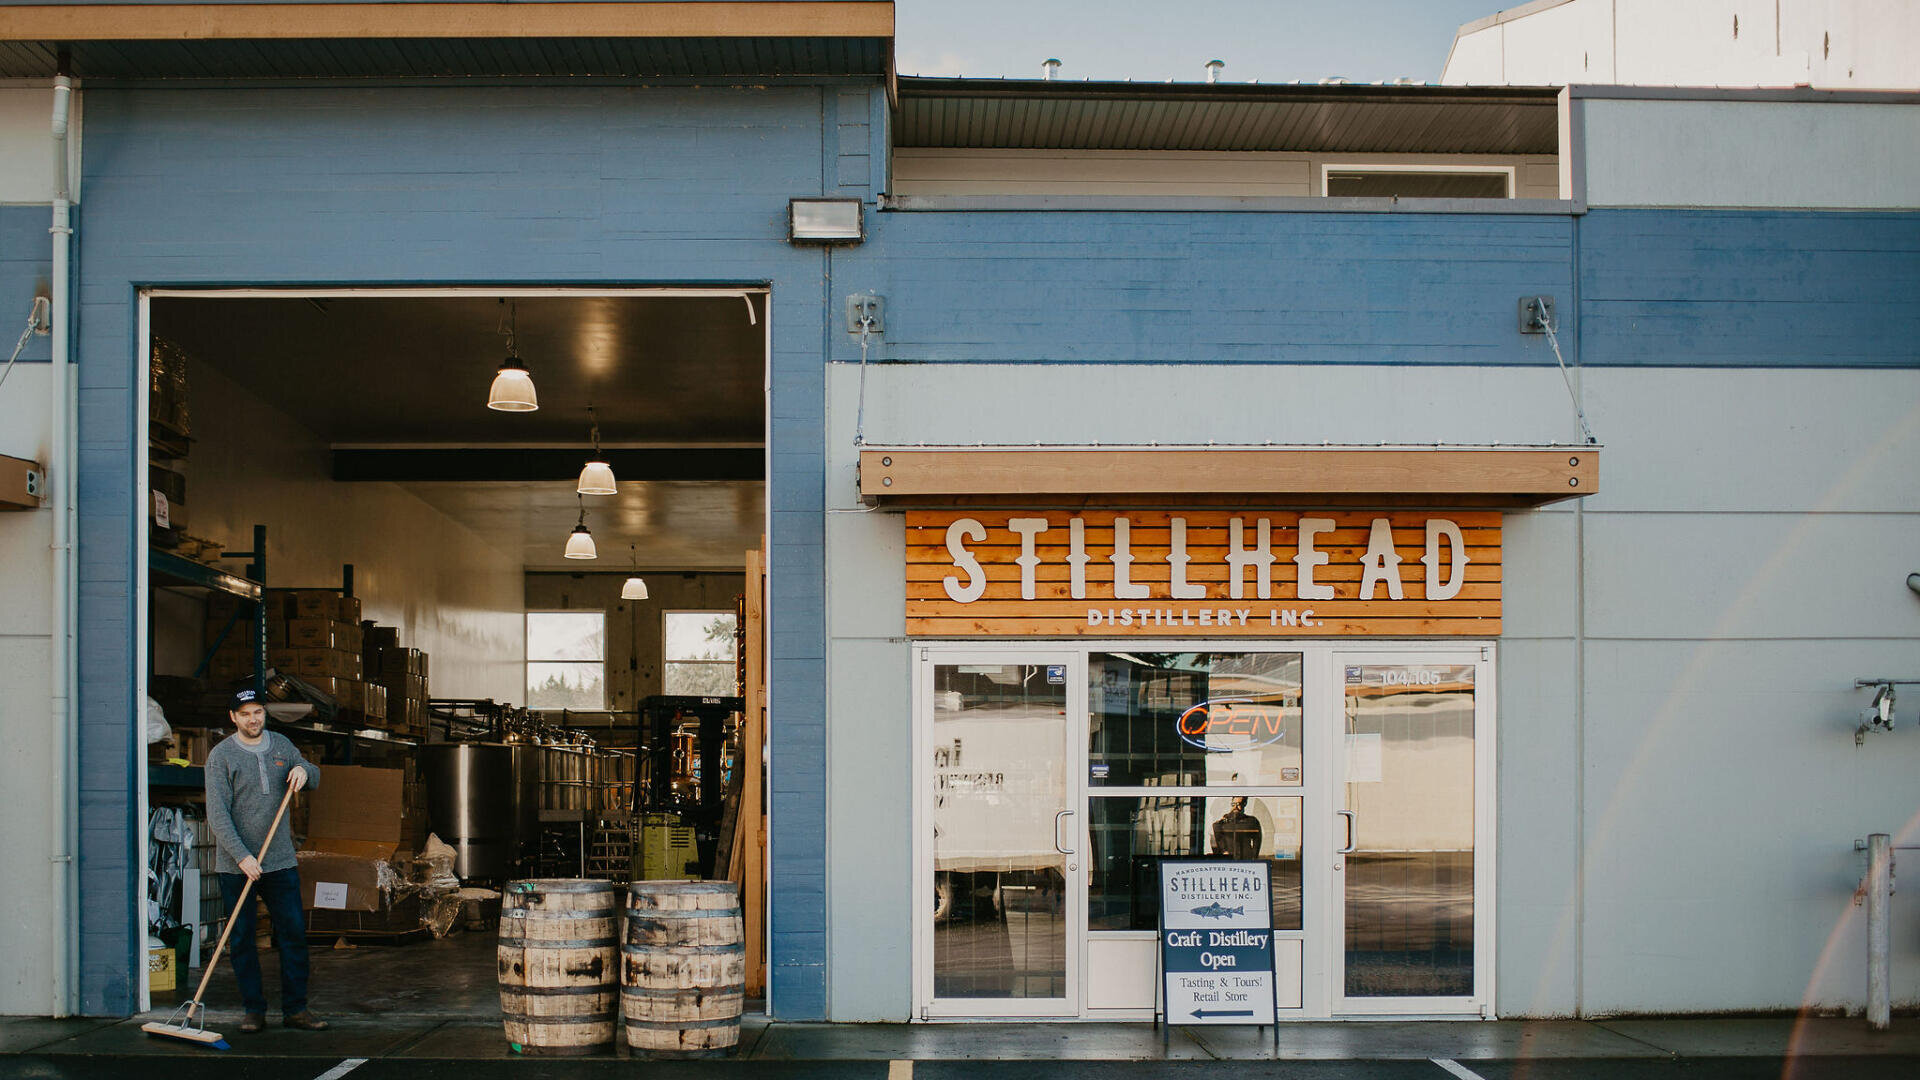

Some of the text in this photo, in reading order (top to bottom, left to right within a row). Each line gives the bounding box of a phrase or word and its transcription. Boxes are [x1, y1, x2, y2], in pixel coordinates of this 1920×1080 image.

[943, 517, 1471, 603] STILLHEAD
[1087, 608, 1324, 626] DISTILLERY INC.
[1180, 706, 1284, 735] OPEN
[1175, 866, 1256, 876] HANDCRAFTED SPIRITS
[1170, 877, 1261, 892] STILLHEAD
[1167, 930, 1268, 949] Craft Distillery
[1200, 952, 1236, 970] Open
[1179, 976, 1263, 990] Tasting & Tours!
[1193, 991, 1248, 1002] Retail Store
